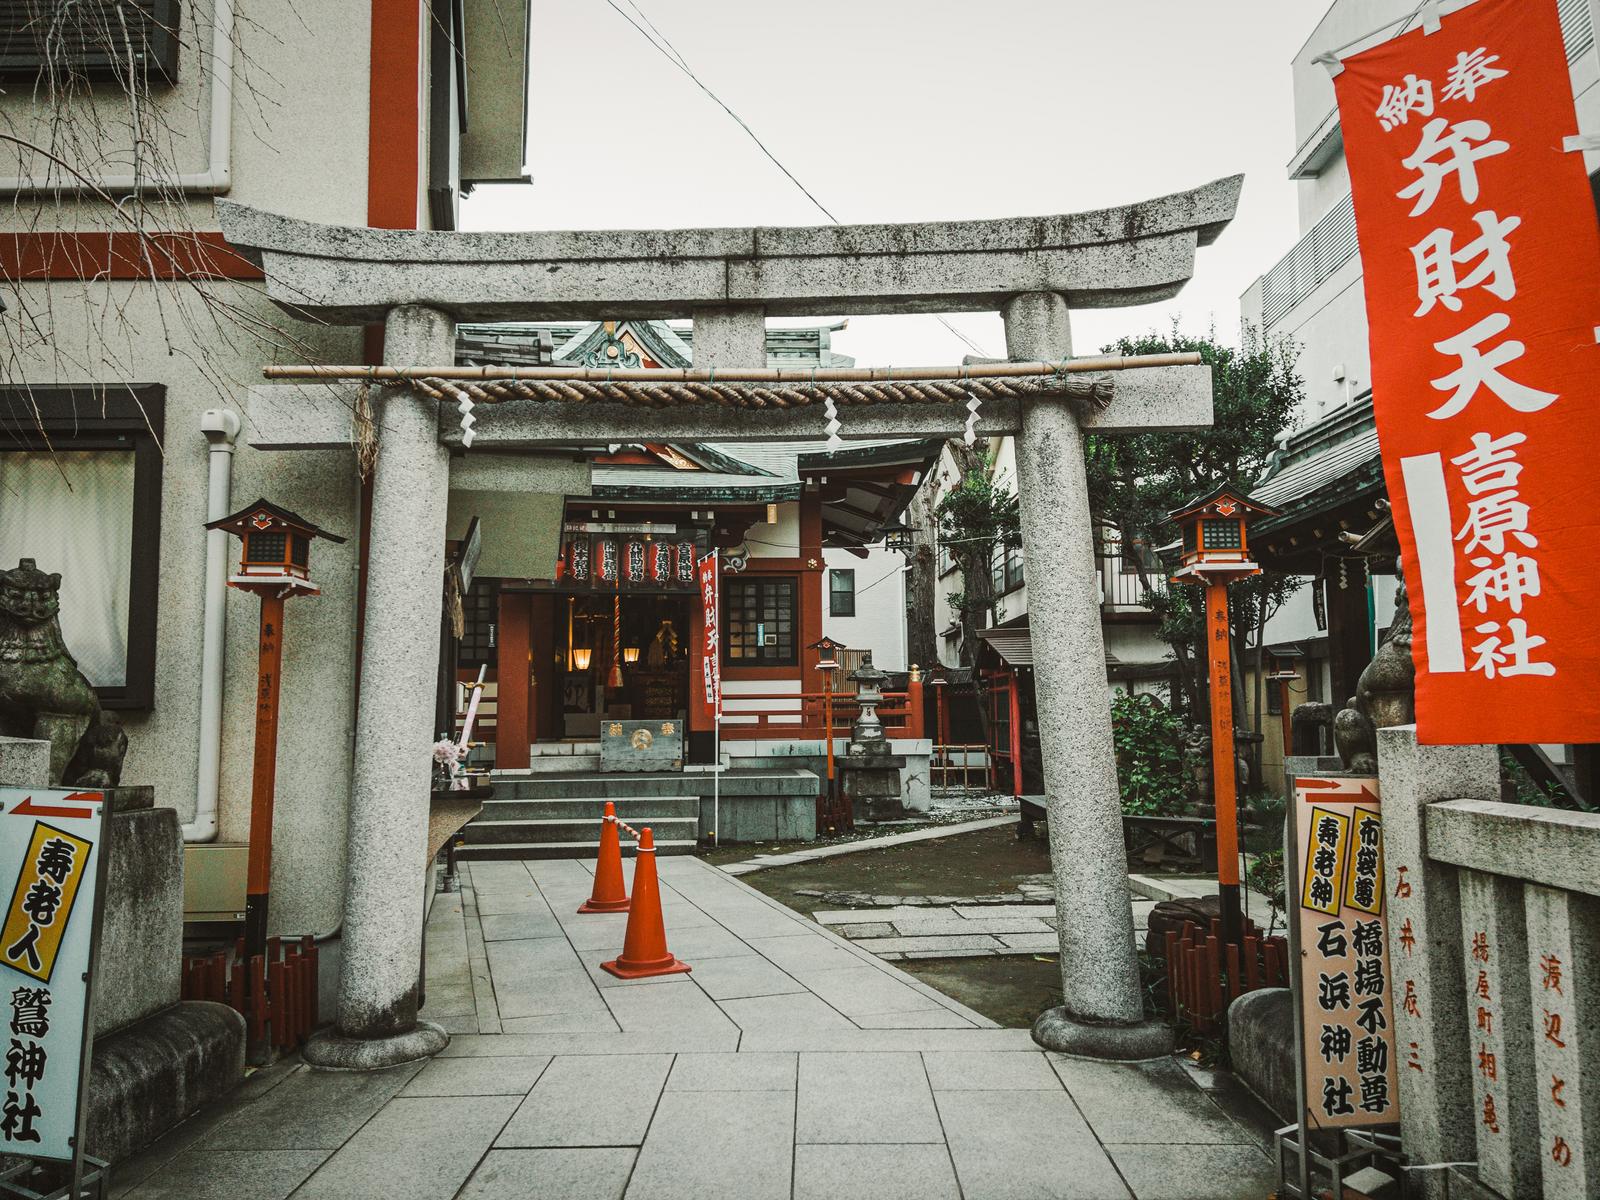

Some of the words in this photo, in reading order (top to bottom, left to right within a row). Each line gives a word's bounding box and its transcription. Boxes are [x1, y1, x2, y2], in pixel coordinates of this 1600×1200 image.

[1375, 47, 1510, 133] 奉納
[1396, 117, 1561, 420] 弁財天
[1215, 609, 1227, 641] 奉納
[1450, 431, 1557, 680] 吉原神社
[7, 837, 77, 972] 寿老人
[1310, 816, 1340, 909] 寿老神
[1354, 816, 1381, 909] 布袋尊
[0, 985, 52, 1144] 鷲神社
[1317, 919, 1355, 1117] 石浜神社
[1351, 919, 1390, 1114] 橋場不動尊
